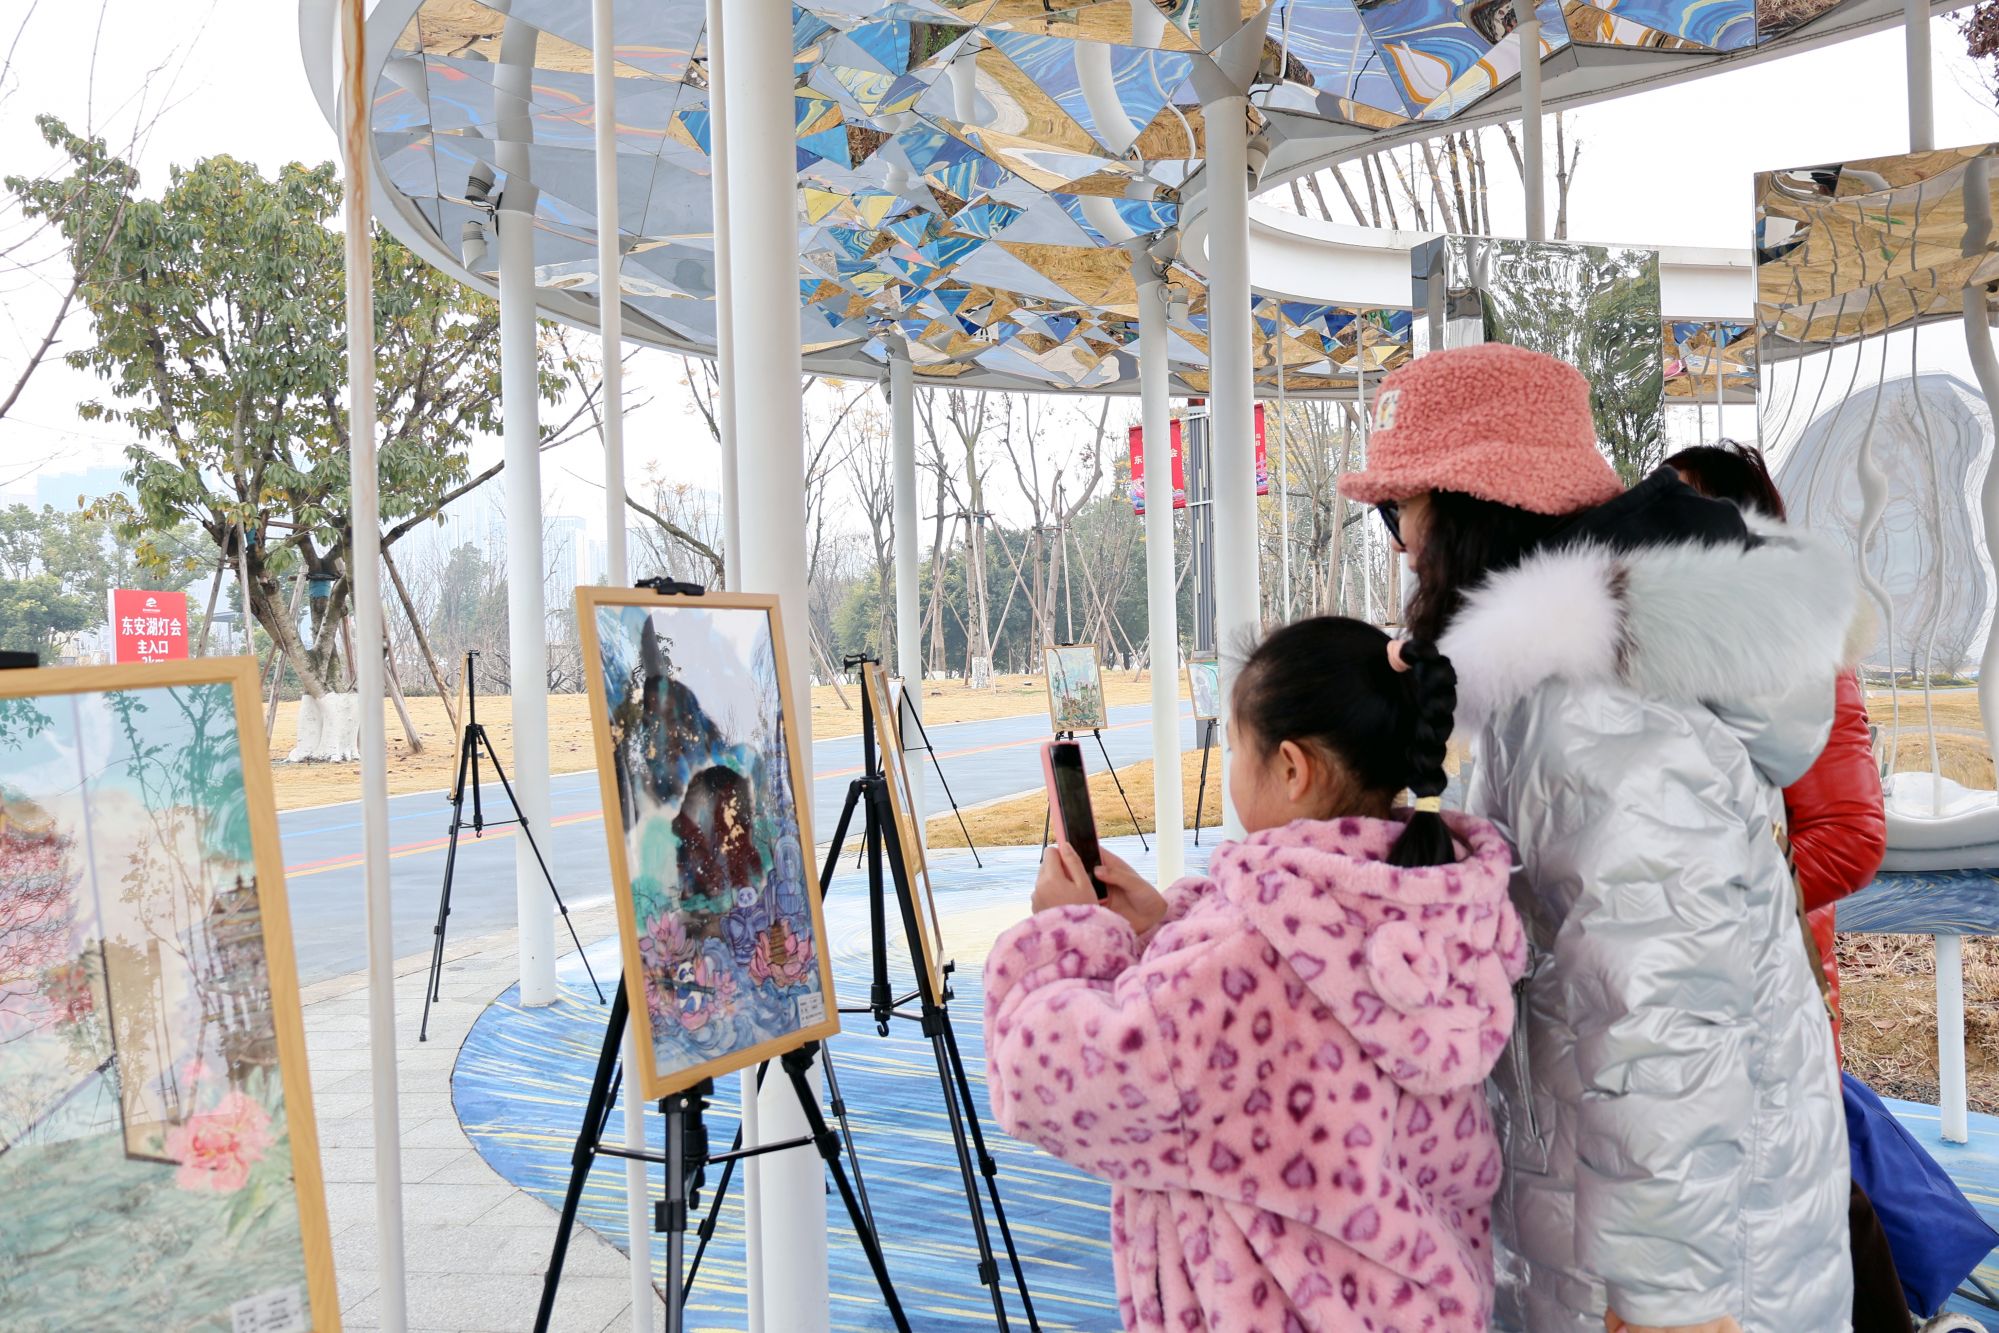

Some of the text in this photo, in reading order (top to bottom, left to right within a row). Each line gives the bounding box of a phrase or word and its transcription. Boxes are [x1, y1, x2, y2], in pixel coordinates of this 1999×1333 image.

[122, 616, 181, 636] 东安湖灯会
[137, 639, 169, 654] 主入口
